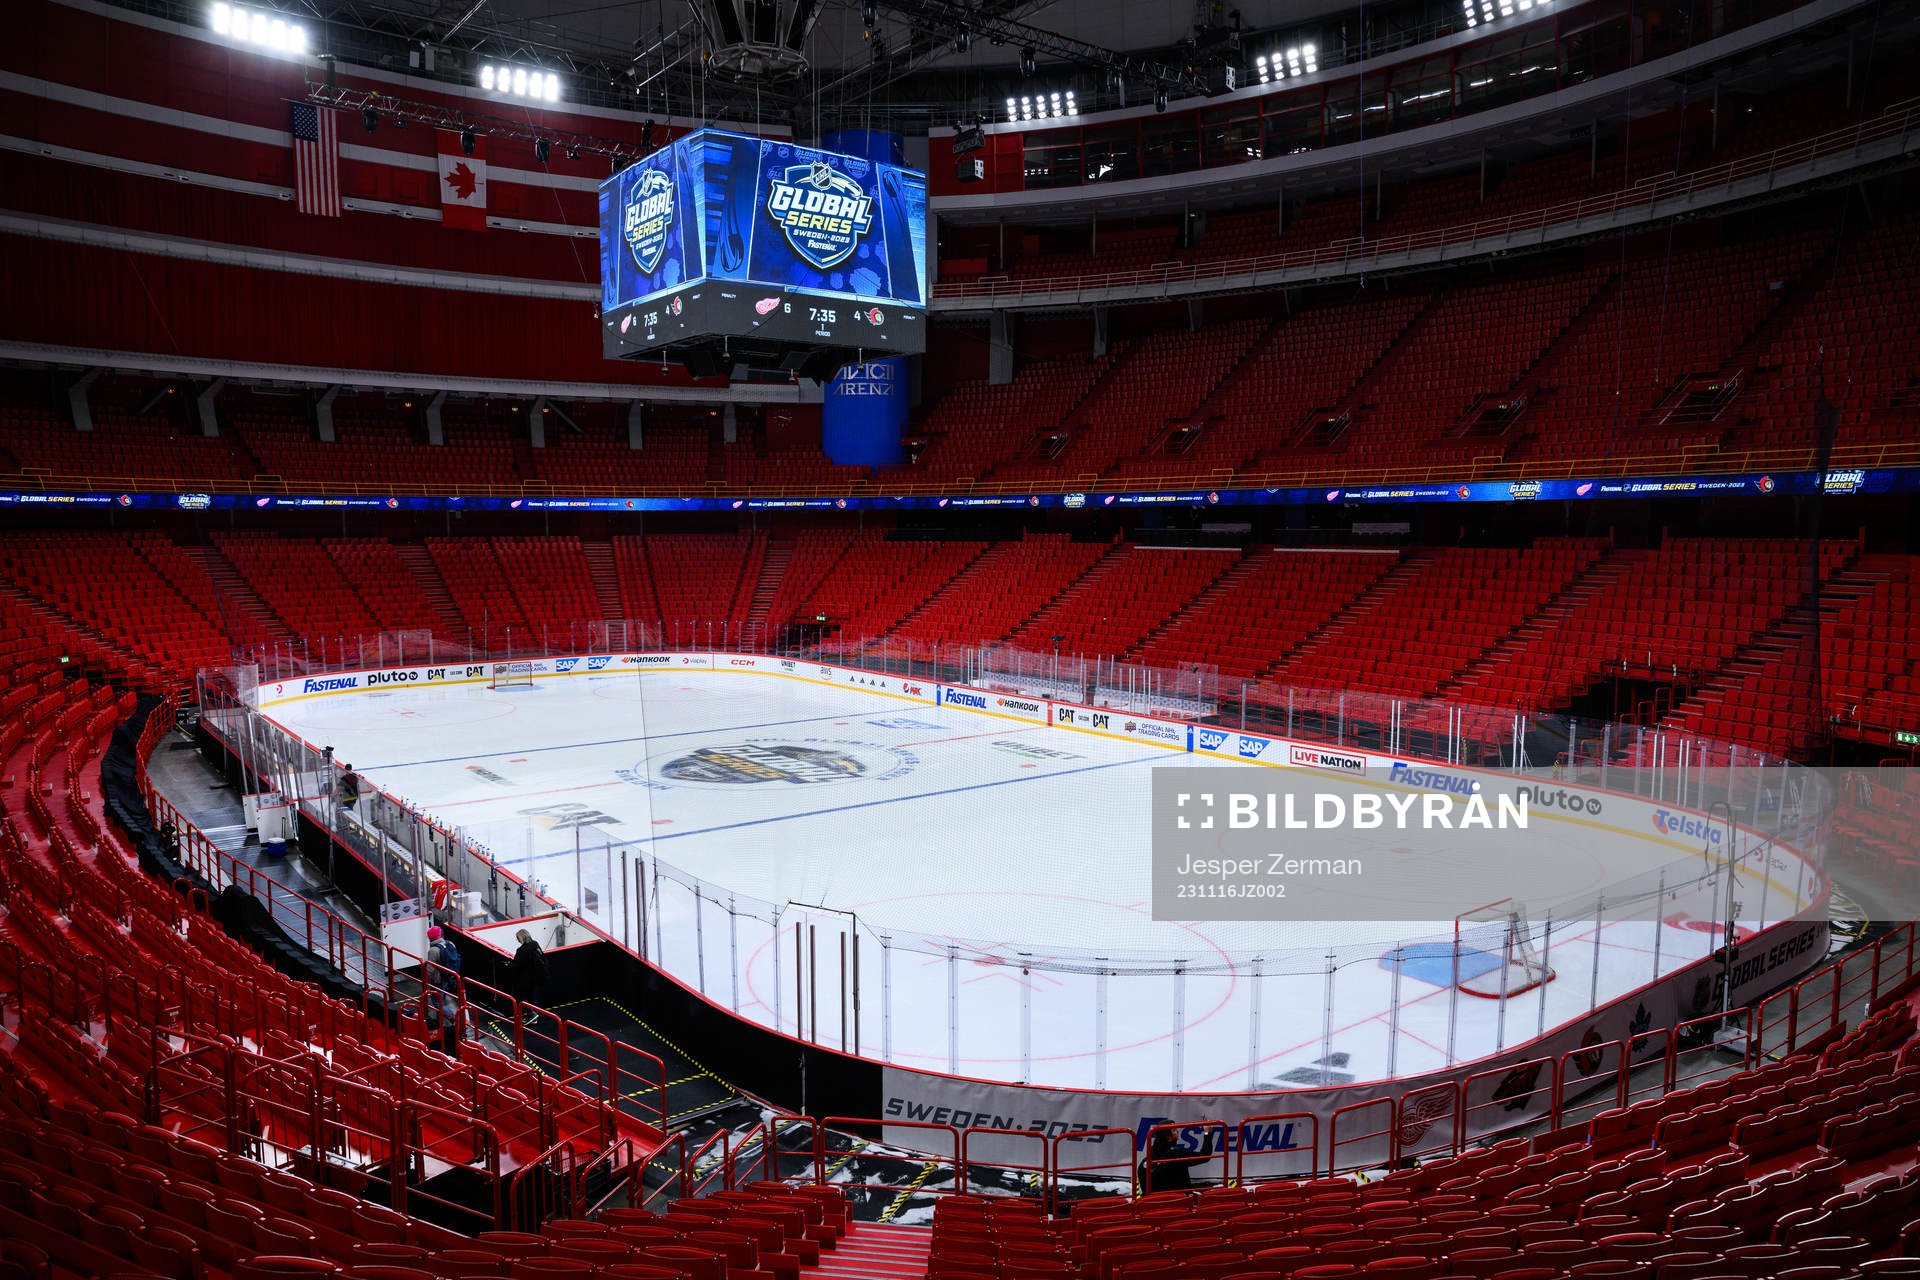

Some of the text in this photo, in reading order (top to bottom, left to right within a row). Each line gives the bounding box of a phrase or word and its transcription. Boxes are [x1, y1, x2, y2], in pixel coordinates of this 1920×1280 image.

[627, 187, 673, 232] GLOBAL
[771, 184, 868, 224] GLOBAL
[632, 215, 664, 242] SERIES
[785, 211, 852, 235] SERIES
[665, 305, 670, 315] 4
[784, 303, 792, 314] 6
[809, 307, 836, 323] 7:35
[853, 310, 861, 321] 4
[632, 316, 637, 327] 6
[643, 311, 658, 328] 7:35
[1817, 472, 1863, 483] LOBAL
[1509, 484, 1541, 493] GLOBAL
[1631, 483, 1662, 492] GLOBAL
[1663, 482, 1697, 491] SERIES
[556, 661, 574, 671] SAP
[588, 659, 606, 669] SAP
[730, 659, 755, 667] CCM
[781, 660, 796, 668] UNIBET
[820, 666, 832, 675] aws
[367, 670, 408, 687] pluto
[427, 668, 446, 680] CAT
[466, 666, 484, 678] CAT
[303, 676, 359, 694] FASTENAL
[945, 687, 987, 709] FASTENAL
[1059, 708, 1075, 723] CAT
[1092, 714, 1110, 730] CAT
[1138, 728, 1180, 741] TRADING CARDS
[1141, 723, 1165, 733] OFFICIAL
[1200, 732, 1222, 749] SAP
[1239, 740, 1263, 755] SAP
[1294, 750, 1361, 771] LIVE NATION
[1389, 761, 1480, 796] FASTENAL
[1516, 785, 1602, 815] pluto tv
[1656, 808, 1722, 845] Telstra
[1713, 926, 1816, 1001] GOBAL SERIES
[1137, 1116, 1299, 1153] FSENAL
